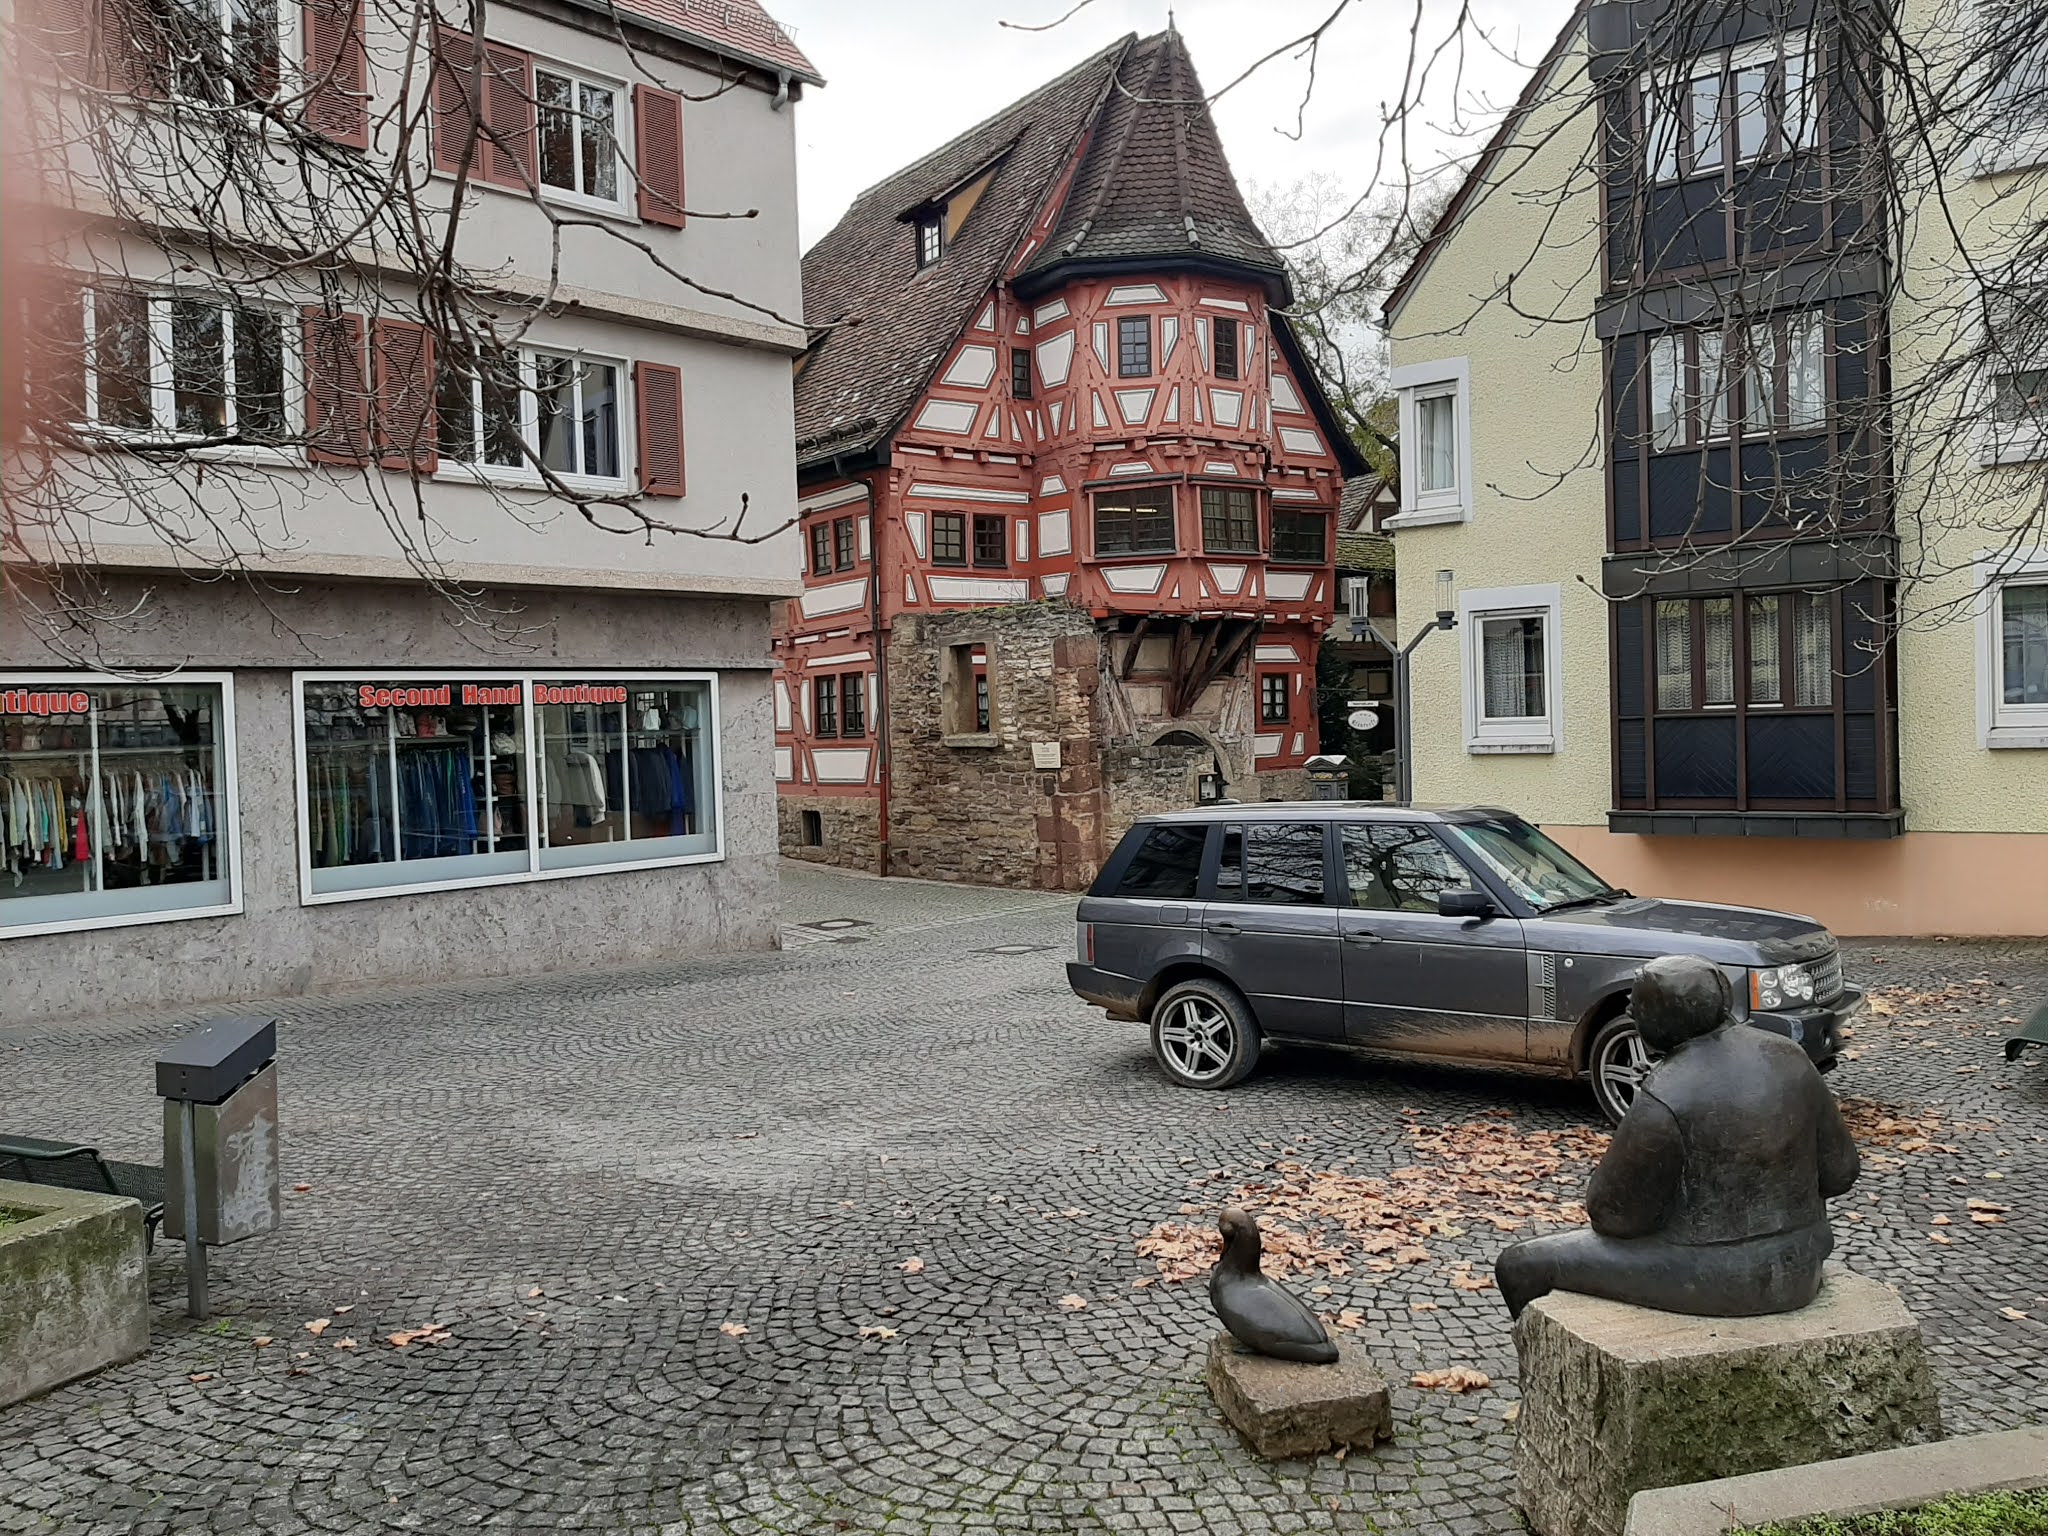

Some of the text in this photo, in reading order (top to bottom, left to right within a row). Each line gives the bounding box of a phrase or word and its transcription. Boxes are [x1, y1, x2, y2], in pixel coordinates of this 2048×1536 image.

[0, 689, 89, 716] tique
[358, 684, 628, 707] Second Hand Boutique
